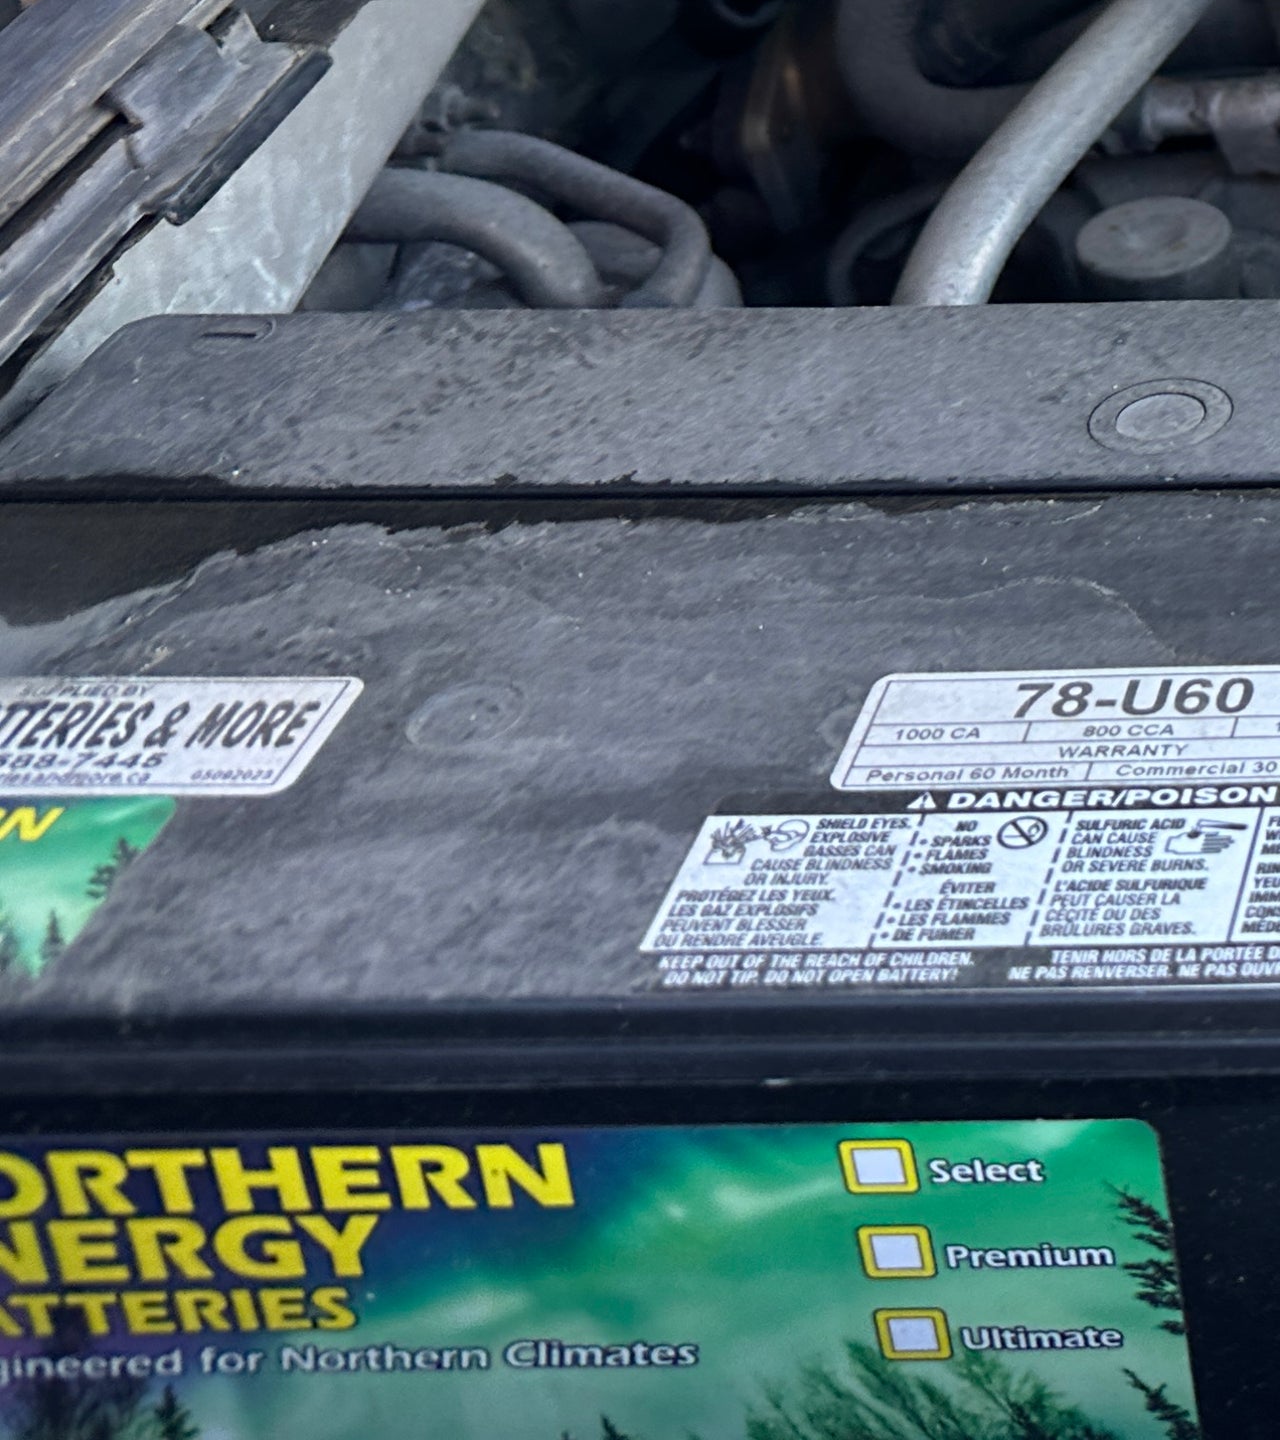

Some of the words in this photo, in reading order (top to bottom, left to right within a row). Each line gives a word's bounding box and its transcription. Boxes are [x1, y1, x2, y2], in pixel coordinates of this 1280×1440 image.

[1013, 676, 1255, 719] 78-U60
[143, 701, 190, 749] &
[184, 700, 321, 749] MORE
[896, 728, 944, 741] 1000
[950, 727, 981, 740] CA
[1082, 724, 1121, 738] 800
[1127, 724, 1174, 737] CCA
[1058, 743, 1189, 759] WARRANTY
[866, 768, 963, 782] Personal
[969, 768, 996, 780] 60
[1002, 766, 1069, 779] Month
[1115, 763, 1246, 777] Commercial
[1252, 762, 1278, 774] 30
[947, 785, 1278, 809] DANGER/POISON
[0, 806, 66, 842] N
[816, 818, 867, 830] SHIELD
[871, 818, 912, 829] EYES.
[955, 820, 978, 832] NO
[1075, 819, 1148, 831] SULFURIC
[1149, 818, 1186, 830] ACID
[810, 831, 892, 843] EXPLOSIVE
[930, 835, 992, 847] SPARKS
[1071, 832, 1104, 845] CAN
[1107, 831, 1159, 844] CAUSE
[803, 845, 861, 857] GASSES
[864, 845, 898, 856] CAN
[925, 848, 989, 861] FLAMES
[1066, 846, 1154, 859] BLINDNESS
[750, 859, 802, 871] CAUSE
[805, 858, 894, 871] BLINDNESS
[919, 862, 993, 875] SMOKING
[1061, 861, 1084, 873] OR
[1088, 860, 1148, 873] SEVERE
[1150, 859, 1209, 871] BURNS.
[744, 873, 766, 885] OR
[770, 873, 830, 886] INJURY.
[939, 879, 996, 894] ÉVITER
[1114, 878, 1208, 891] SULFURIQUE
[758, 889, 788, 901] LES
[1049, 894, 1092, 907] PEUT
[1094, 893, 1158, 906] CAUSER
[1160, 892, 1181, 905] LA
[668, 904, 697, 917] LES
[700, 904, 732, 917] GAZ
[733, 904, 819, 917] EXPLOSIFS
[904, 898, 934, 912] LES
[936, 895, 1030, 910] ÉTINCELLES
[899, 913, 928, 926] LES
[930, 912, 1012, 926] FLAMMES
[1102, 909, 1125, 921] OU
[1129, 908, 1161, 921] DES
[659, 919, 734, 932] PEUVENT
[735, 918, 808, 931] BLESSER
[653, 934, 677, 947] OU
[680, 934, 746, 946] RENDRE
[892, 928, 916, 941] DE
[917, 927, 976, 941] FUMER
[659, 955, 704, 969] KEEP
[705, 955, 742, 968] OUT
[743, 954, 768, 968] OF
[770, 954, 802, 967] THE
[803, 953, 863, 967] REACH
[863, 952, 888, 967] OF
[889, 952, 976, 967] CHILDREN.
[1051, 949, 1100, 964] TENIR
[1103, 949, 1147, 963] HORS
[1150, 949, 1173, 962] DE
[1175, 949, 1197, 962] LA
[664, 971, 689, 984] DO
[692, 970, 725, 984] NOT
[764, 970, 789, 983] DO
[793, 969, 824, 983] NOT
[828, 968, 876, 983] OPEN
[877, 968, 959, 982] BATTERY!
[1008, 966, 1032, 980] NE
[1033, 964, 1068, 979] PAS
[1177, 963, 1200, 977] NE
[1204, 963, 1238, 976] PAS
[928, 1156, 1044, 1185] Select
[0, 1213, 380, 1286] NERGY
[945, 1243, 1116, 1270] Premium
[960, 1324, 1124, 1352] Ultimate
[200, 1345, 265, 1374] for
[280, 1343, 488, 1371] Northern
[505, 1337, 700, 1369] Climates
